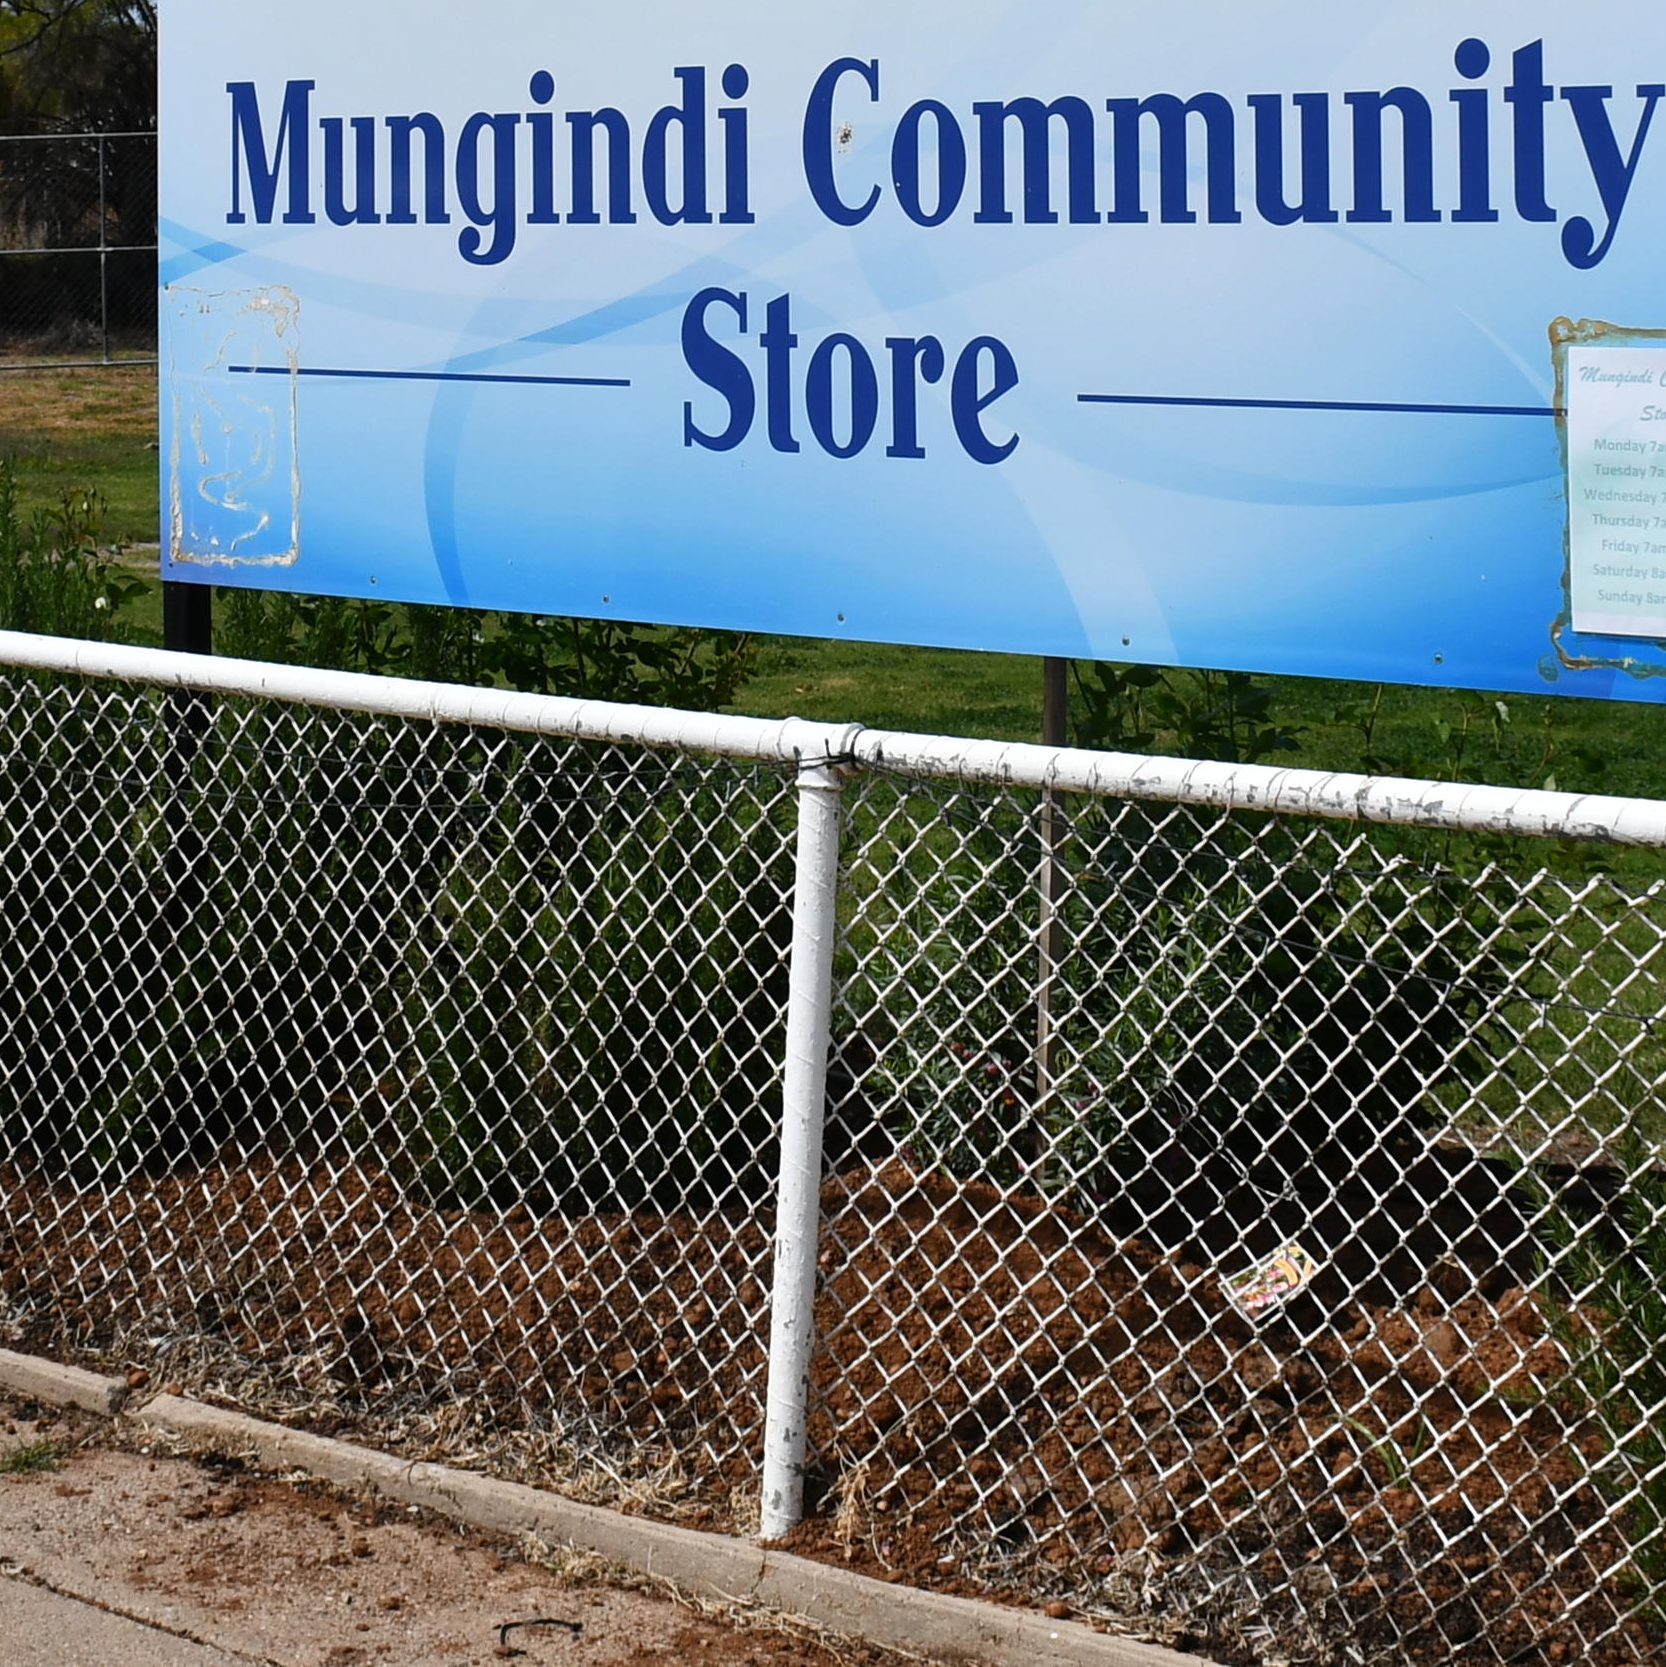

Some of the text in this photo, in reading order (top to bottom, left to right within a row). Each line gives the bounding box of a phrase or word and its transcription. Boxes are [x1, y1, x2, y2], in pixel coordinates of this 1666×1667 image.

[225, 37, 1666, 270] Mungindi Community
[681, 286, 1021, 465] Store
[1579, 366, 1654, 388] Mungindi
[1594, 439, 1646, 454] Monday
[1594, 463, 1646, 479] Tuesday
[1583, 488, 1658, 505] Wednesday
[1592, 513, 1650, 530] Thursday
[1601, 539, 1640, 554] Friday
[1592, 564, 1648, 580] Saturday
[1598, 589, 1642, 605] Sunday
